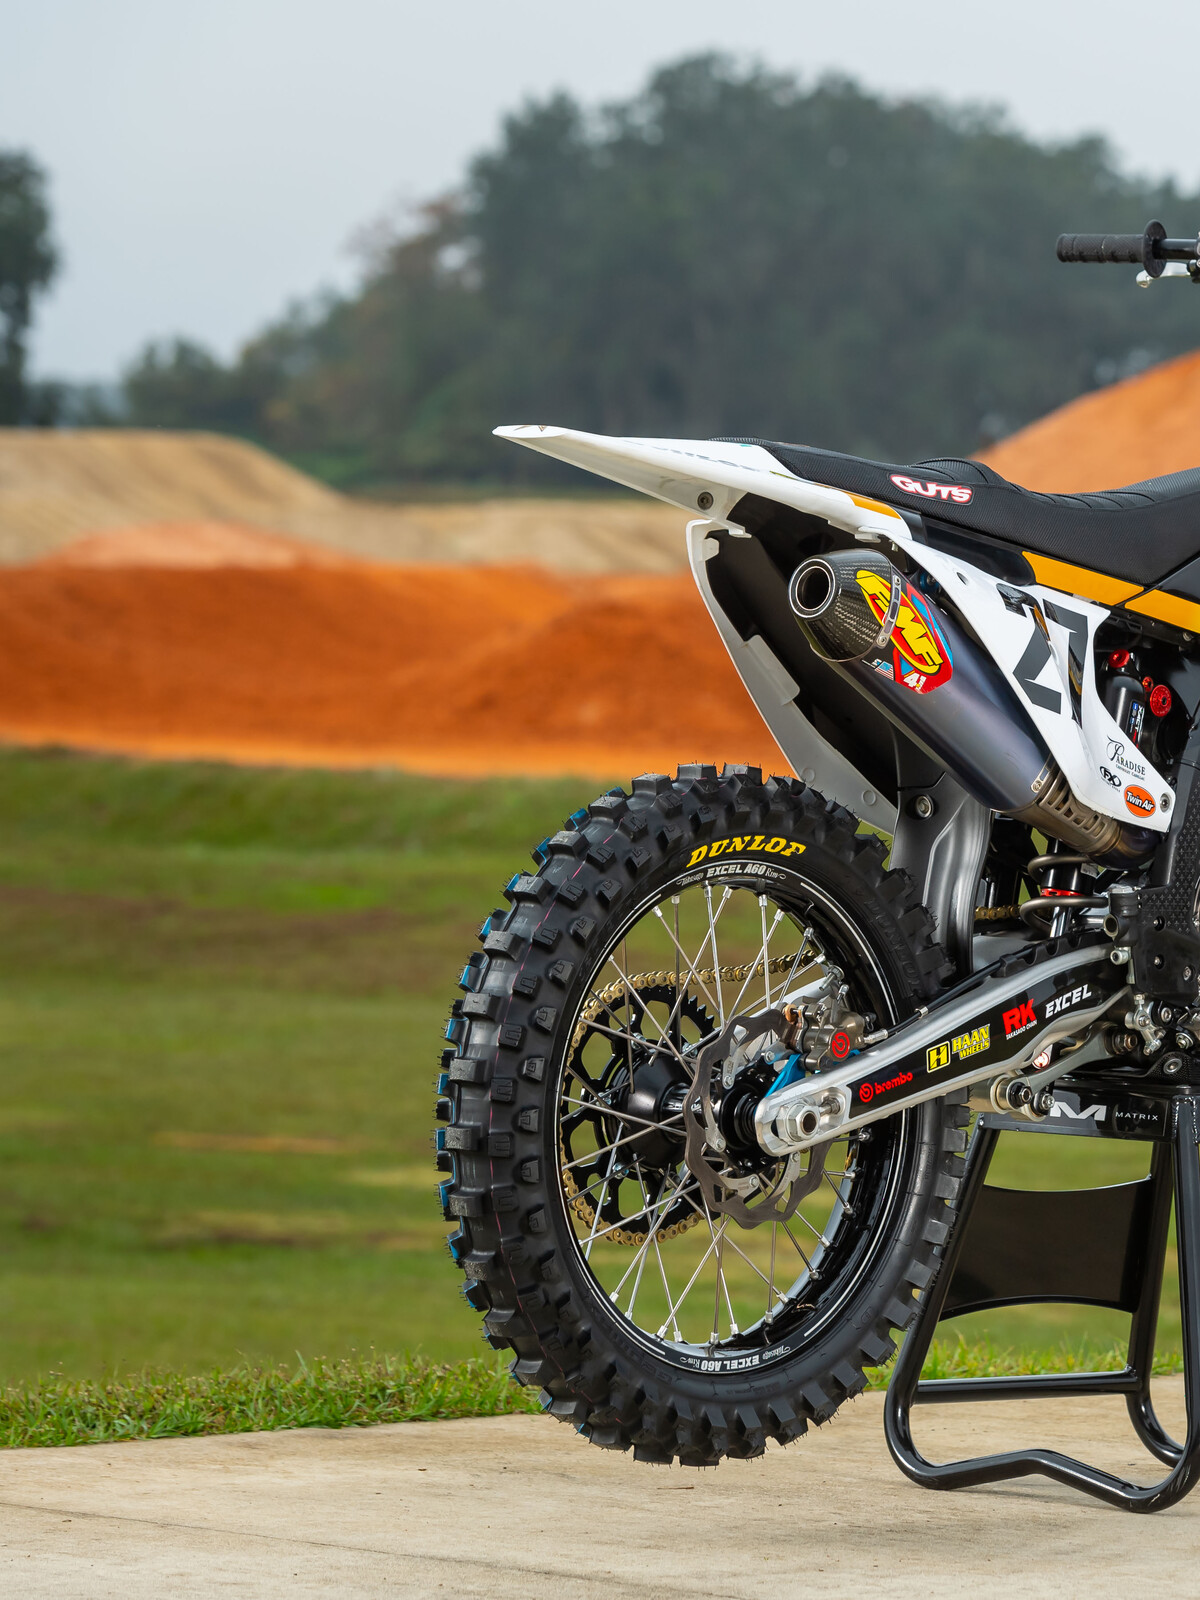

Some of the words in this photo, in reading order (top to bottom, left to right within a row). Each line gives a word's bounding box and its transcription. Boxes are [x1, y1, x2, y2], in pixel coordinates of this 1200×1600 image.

[890, 474, 973, 503] GUTS
[855, 575, 944, 667] FMF
[1106, 735, 1146, 776] PARADISE
[1126, 792, 1144, 807] Twin
[1141, 799, 1155, 812] Air
[686, 835, 806, 868] DUNLOP
[706, 864, 743, 878] EXCEL
[744, 863, 767, 875] A60
[1045, 984, 1092, 1019] EXCEL
[1002, 999, 1037, 1033] RK
[951, 1023, 991, 1055] HAAN
[959, 1039, 990, 1060] WHEELS
[875, 1072, 913, 1095] brembo
[1115, 1111, 1158, 1121] MATRIX
[701, 1359, 722, 1372] A60
[723, 1354, 760, 1370] EXCEL
